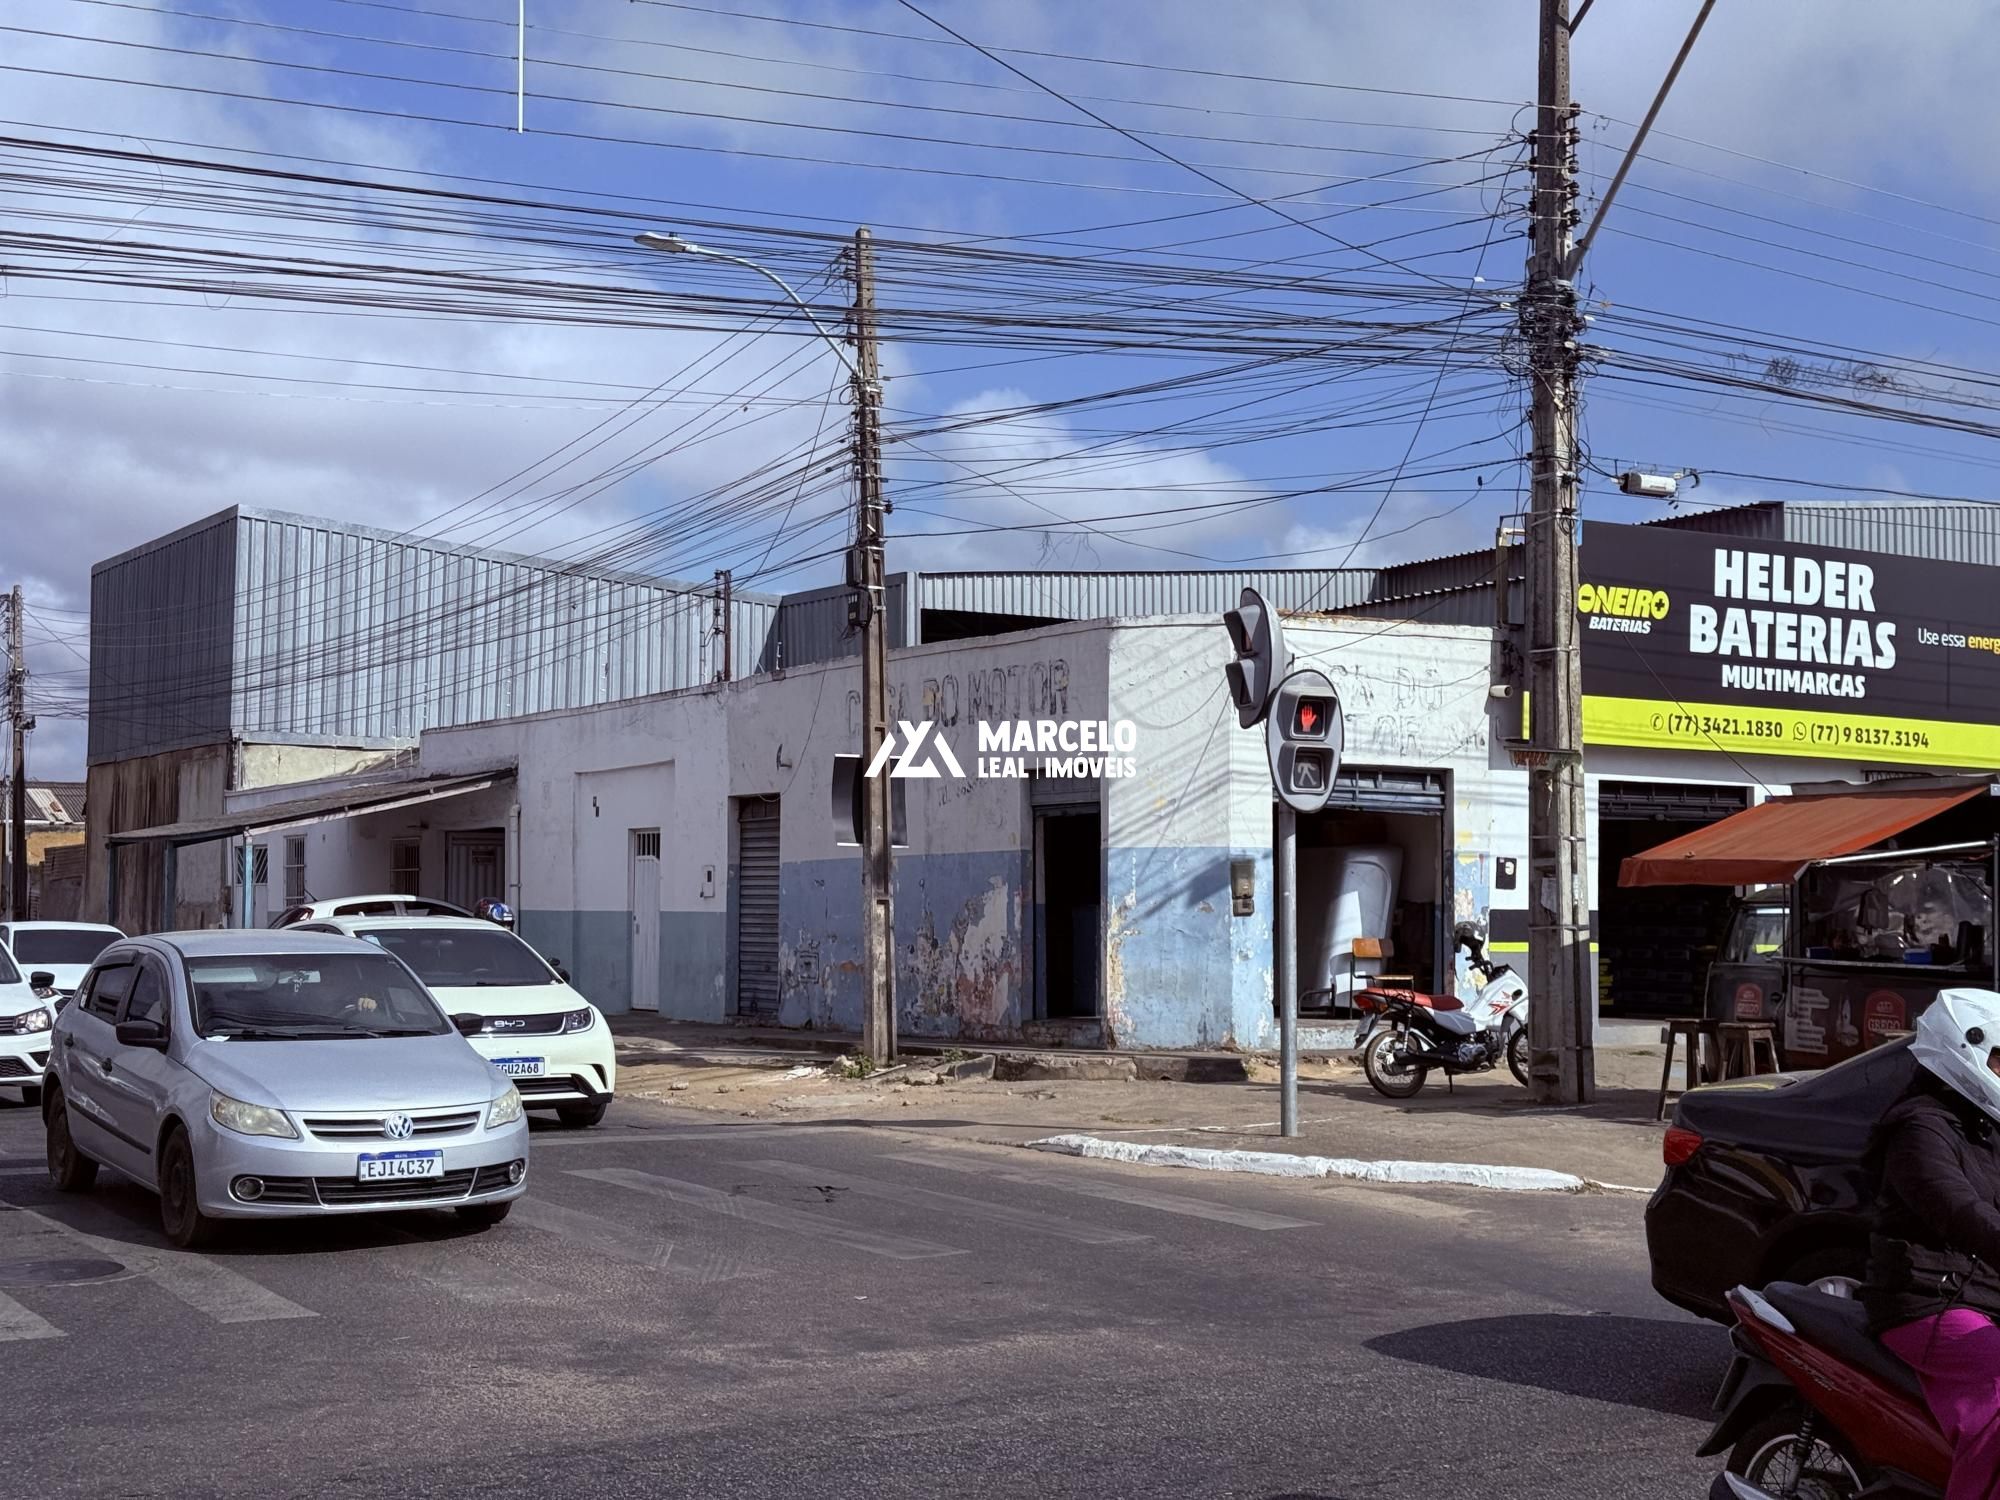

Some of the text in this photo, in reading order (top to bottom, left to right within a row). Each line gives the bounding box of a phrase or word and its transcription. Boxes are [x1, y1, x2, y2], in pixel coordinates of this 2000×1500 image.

[1714, 548, 1876, 612] HELDER
[1577, 583, 1670, 620] ONEIRO
[1588, 616, 1652, 635] BATERIAS
[1689, 604, 1897, 670] BATERIAS
[1918, 627, 1940, 646] Use
[1941, 633, 1966, 648] essa
[922, 674, 959, 729] DO
[968, 658, 1070, 725] MOTOR
[1721, 664, 1866, 699] MULTIMARCAS
[1667, 713, 1930, 749] (77) 3421.1830 (77) 9 8137.3194
[496, 1064, 539, 1075] GU2A68
[367, 1158, 435, 1178] EJI4C37
